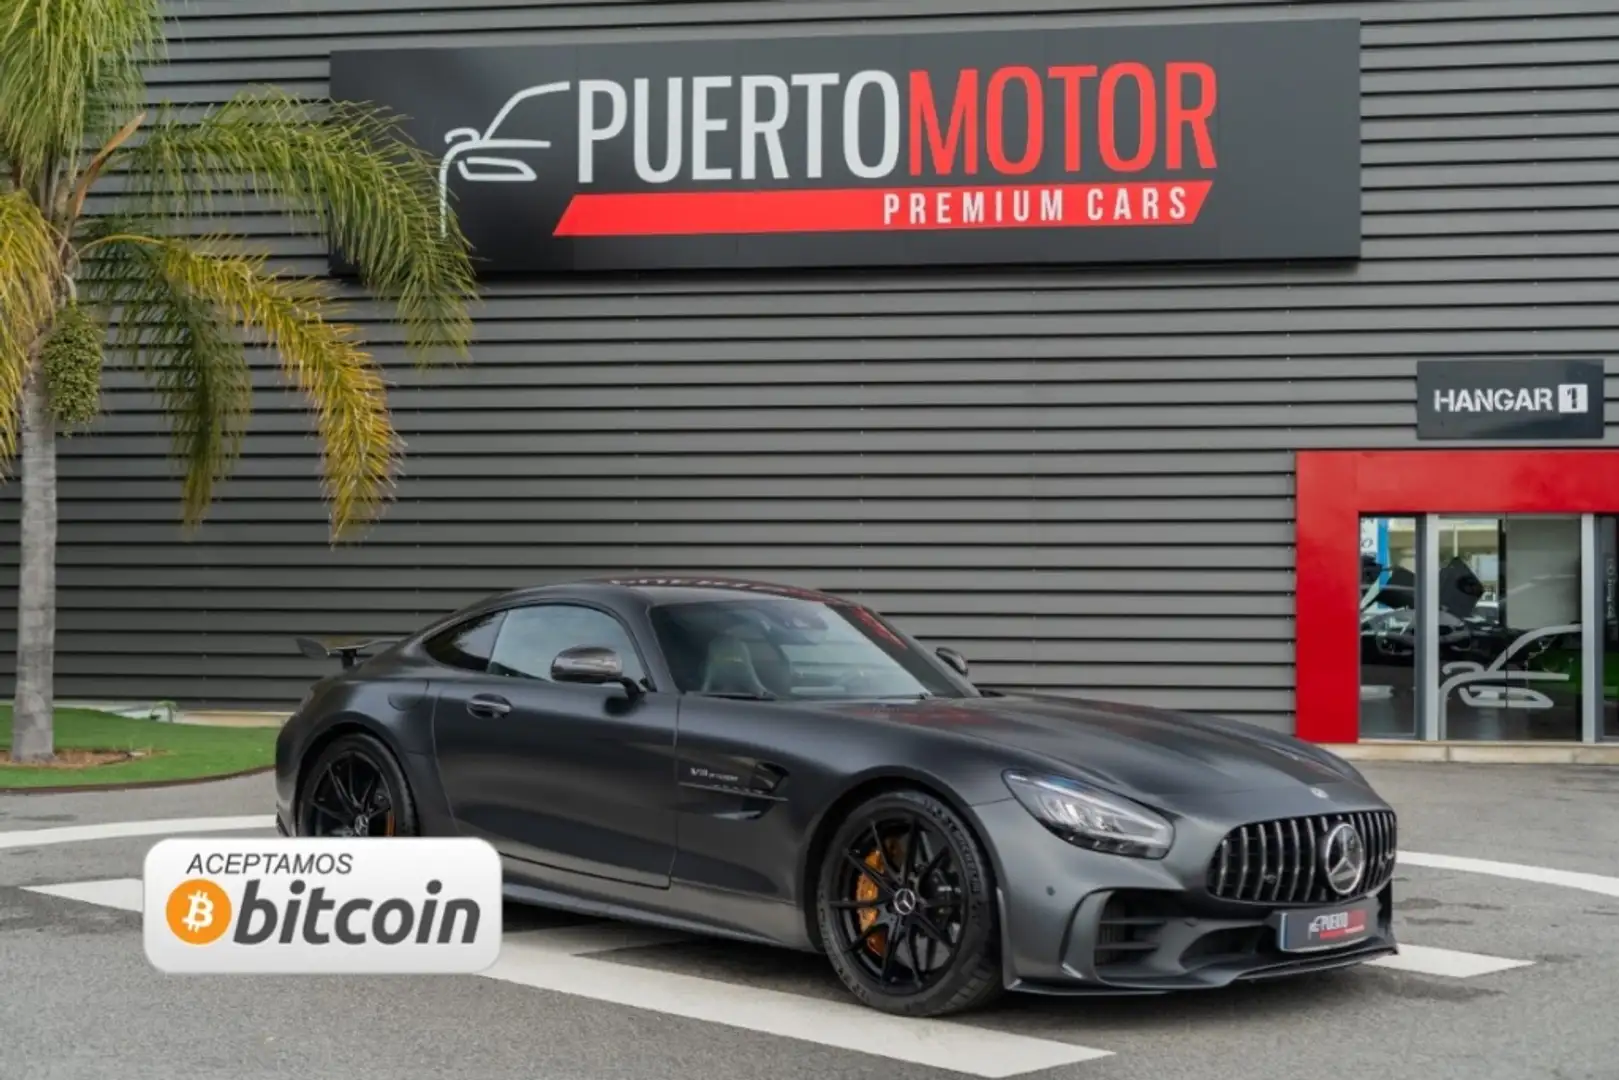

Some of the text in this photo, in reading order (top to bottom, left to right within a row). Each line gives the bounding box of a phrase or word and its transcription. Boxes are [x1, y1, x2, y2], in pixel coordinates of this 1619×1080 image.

[883, 185, 1188, 226] PREMIUM CARS
[1433, 387, 1555, 413] HANGAR
